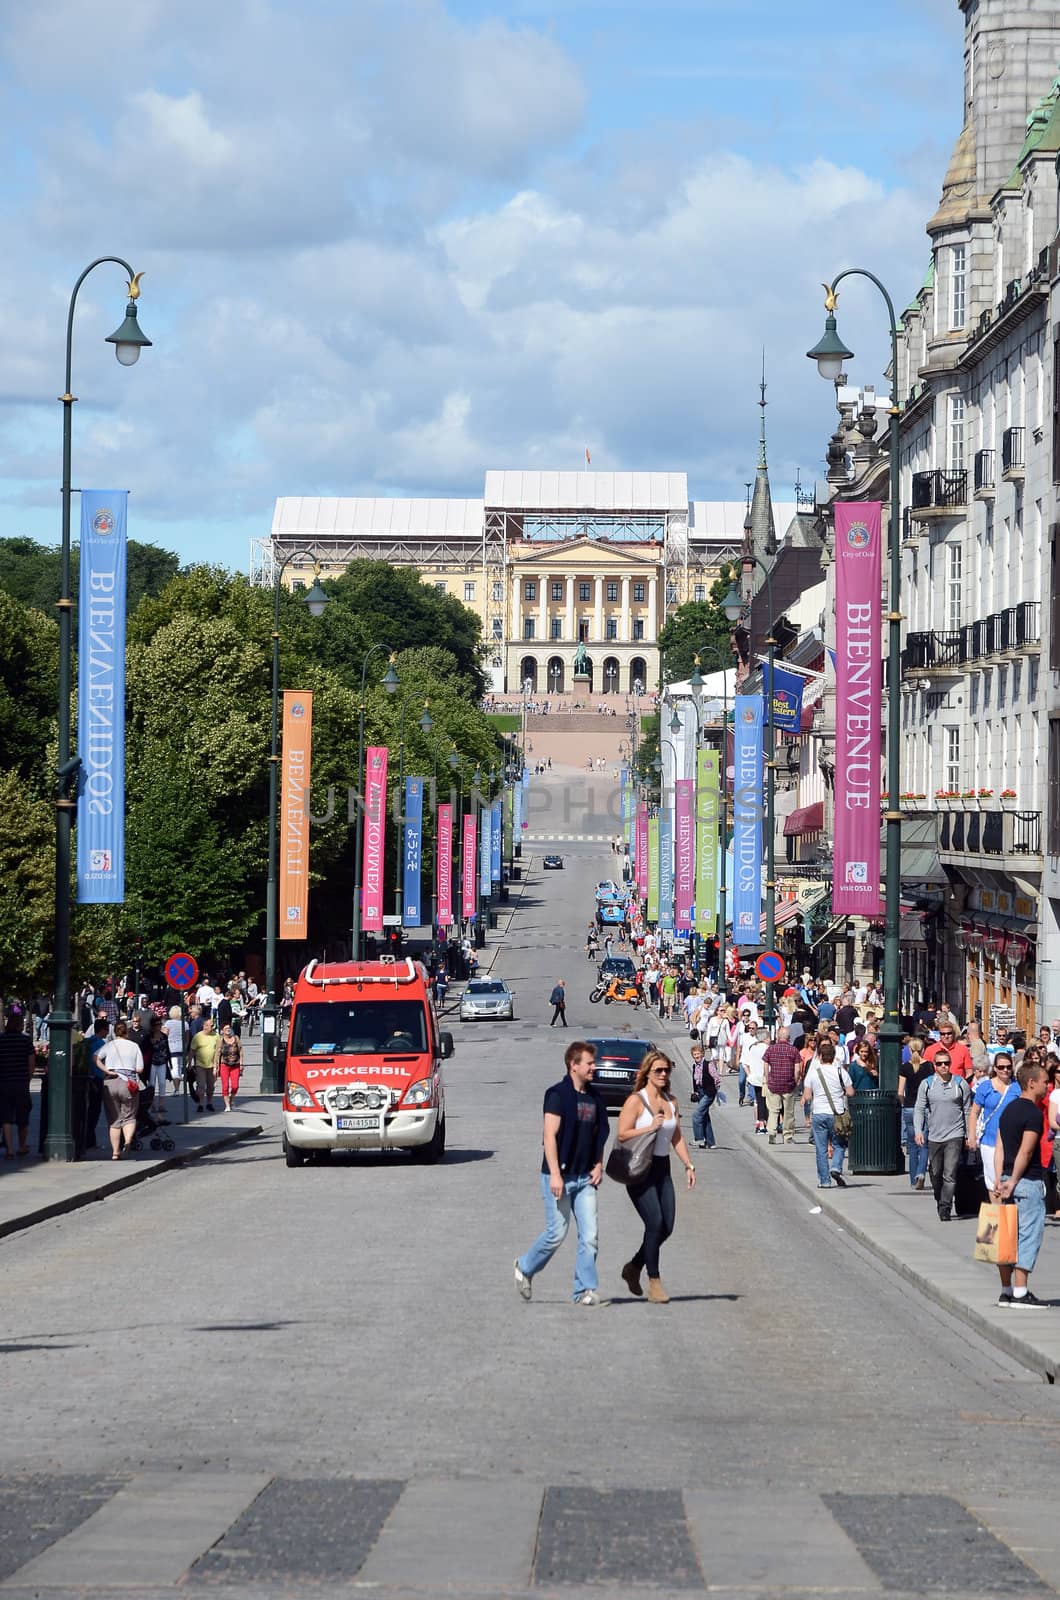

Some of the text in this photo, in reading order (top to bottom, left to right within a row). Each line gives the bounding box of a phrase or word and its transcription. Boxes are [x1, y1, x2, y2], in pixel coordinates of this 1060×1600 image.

[842, 551, 854, 559] City
[846, 601, 872, 810] BIENVENUE
[407, 829, 419, 871] ようこそ
[679, 815, 690, 892] BIENVENUE
[701, 799, 714, 881] WELCOME
[740, 743, 757, 893] BIENVENIDOS
[661, 832, 670, 901] VELKOMMEN
[306, 1066, 412, 1079] DYKKERBIL
